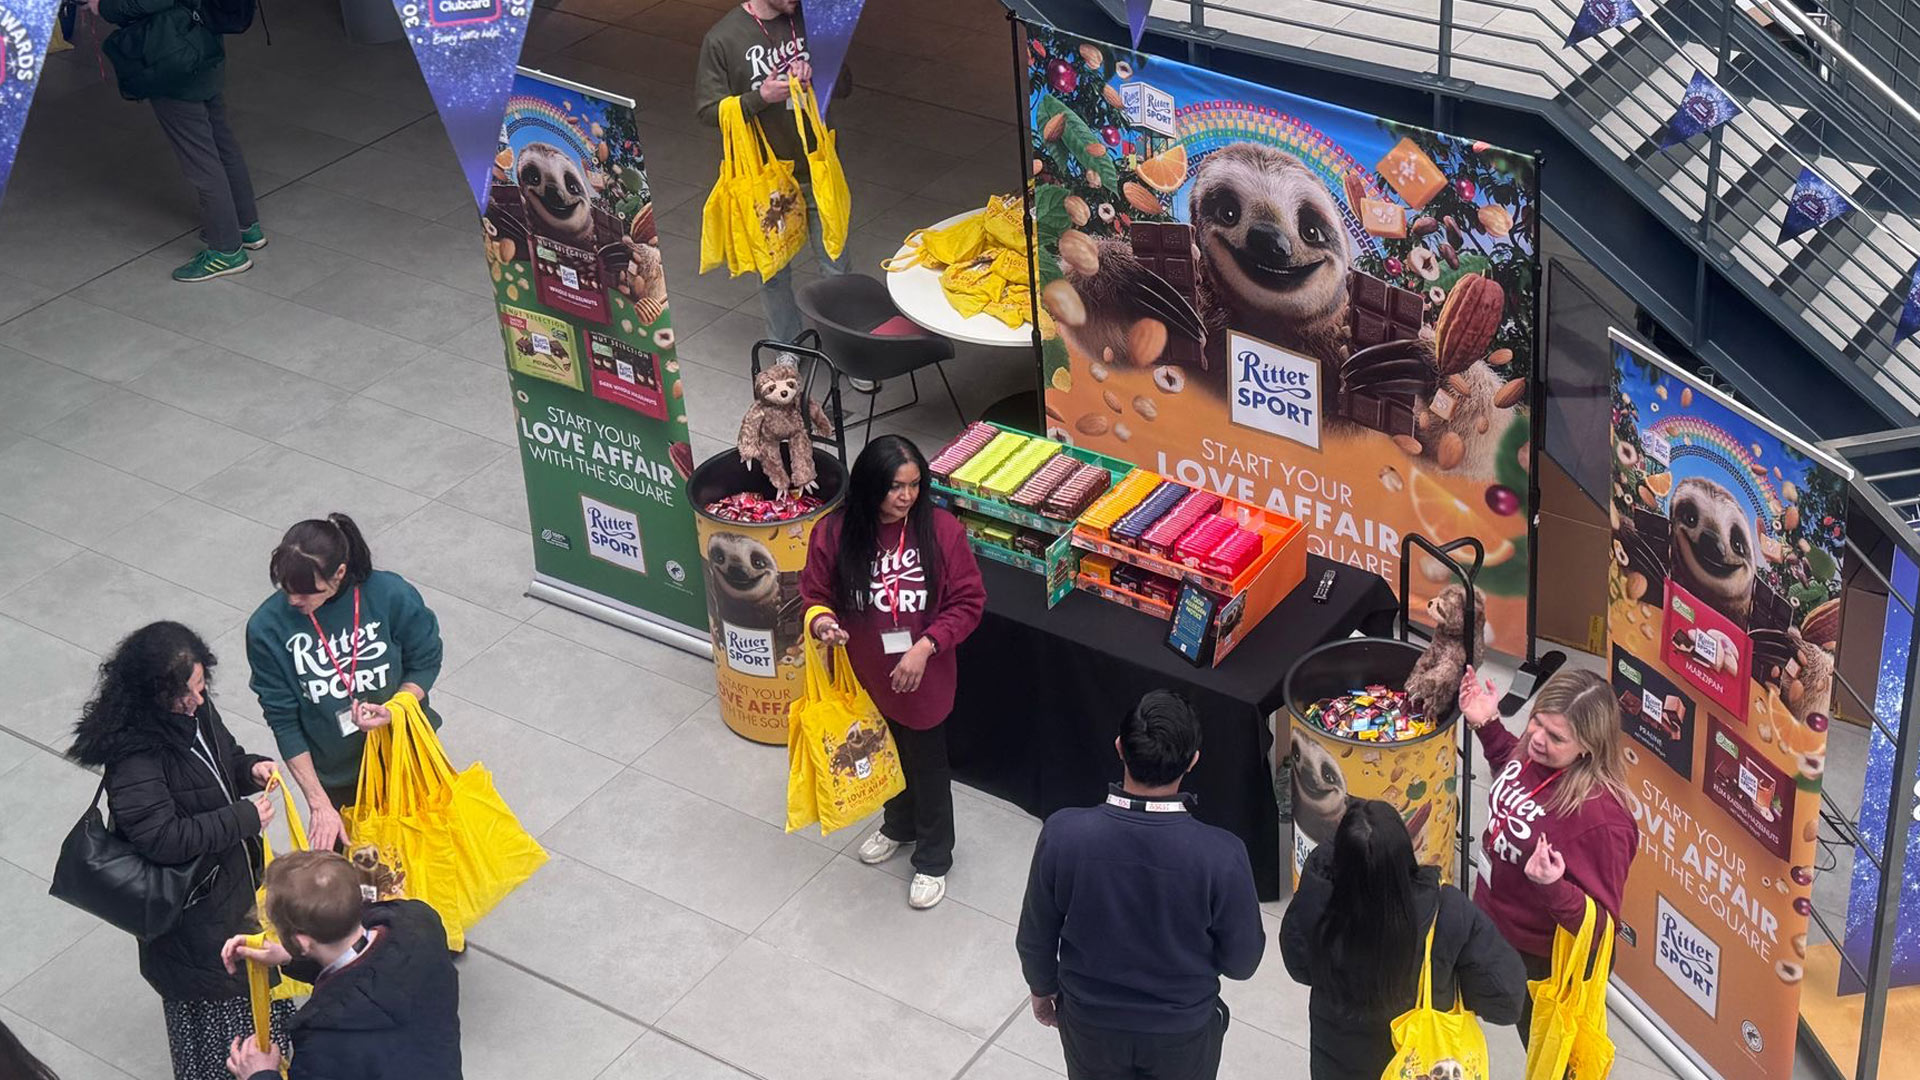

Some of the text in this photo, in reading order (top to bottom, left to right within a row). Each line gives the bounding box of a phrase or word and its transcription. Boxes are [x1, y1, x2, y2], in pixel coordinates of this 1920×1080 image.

[745, 37, 810, 80] Ritter
[1146, 93, 1171, 113] Ritter
[1146, 109, 1172, 124] SPORT
[591, 335, 608, 344] NUT
[611, 340, 649, 360] SELECTION
[1237, 350, 1312, 400] Ritter
[547, 406, 642, 452] START YOUR
[1238, 387, 1313, 428] SPORT
[521, 417, 676, 489] LOVE AFFAIR
[528, 443, 675, 507] WITH THE SQUARE
[1202, 438, 1353, 508] START YOUR
[587, 507, 636, 540] Ritter
[1157, 451, 1402, 559] LOVE AFFAIR
[591, 531, 638, 558] SPORT
[1306, 533, 1393, 583] QUARE
[285, 621, 387, 677] Ritter
[727, 630, 769, 653] Ritter
[729, 649, 771, 667] SPORT
[719, 681, 791, 715] OVE AFFA
[752, 689, 791, 700] YOUR
[1685, 661, 1724, 694] MARZIPAN
[738, 710, 758, 727] THE
[760, 716, 790, 729] SQU
[1489, 760, 1546, 840] Ritter
[1642, 779, 1692, 833] START
[1695, 822, 1746, 882] YOUR
[1626, 790, 1779, 944] OVE AFFAIR
[1637, 828, 1771, 964] TH THE SQUARE
[1662, 912, 1714, 975] Ritter
[1660, 940, 1714, 997] SPORT
